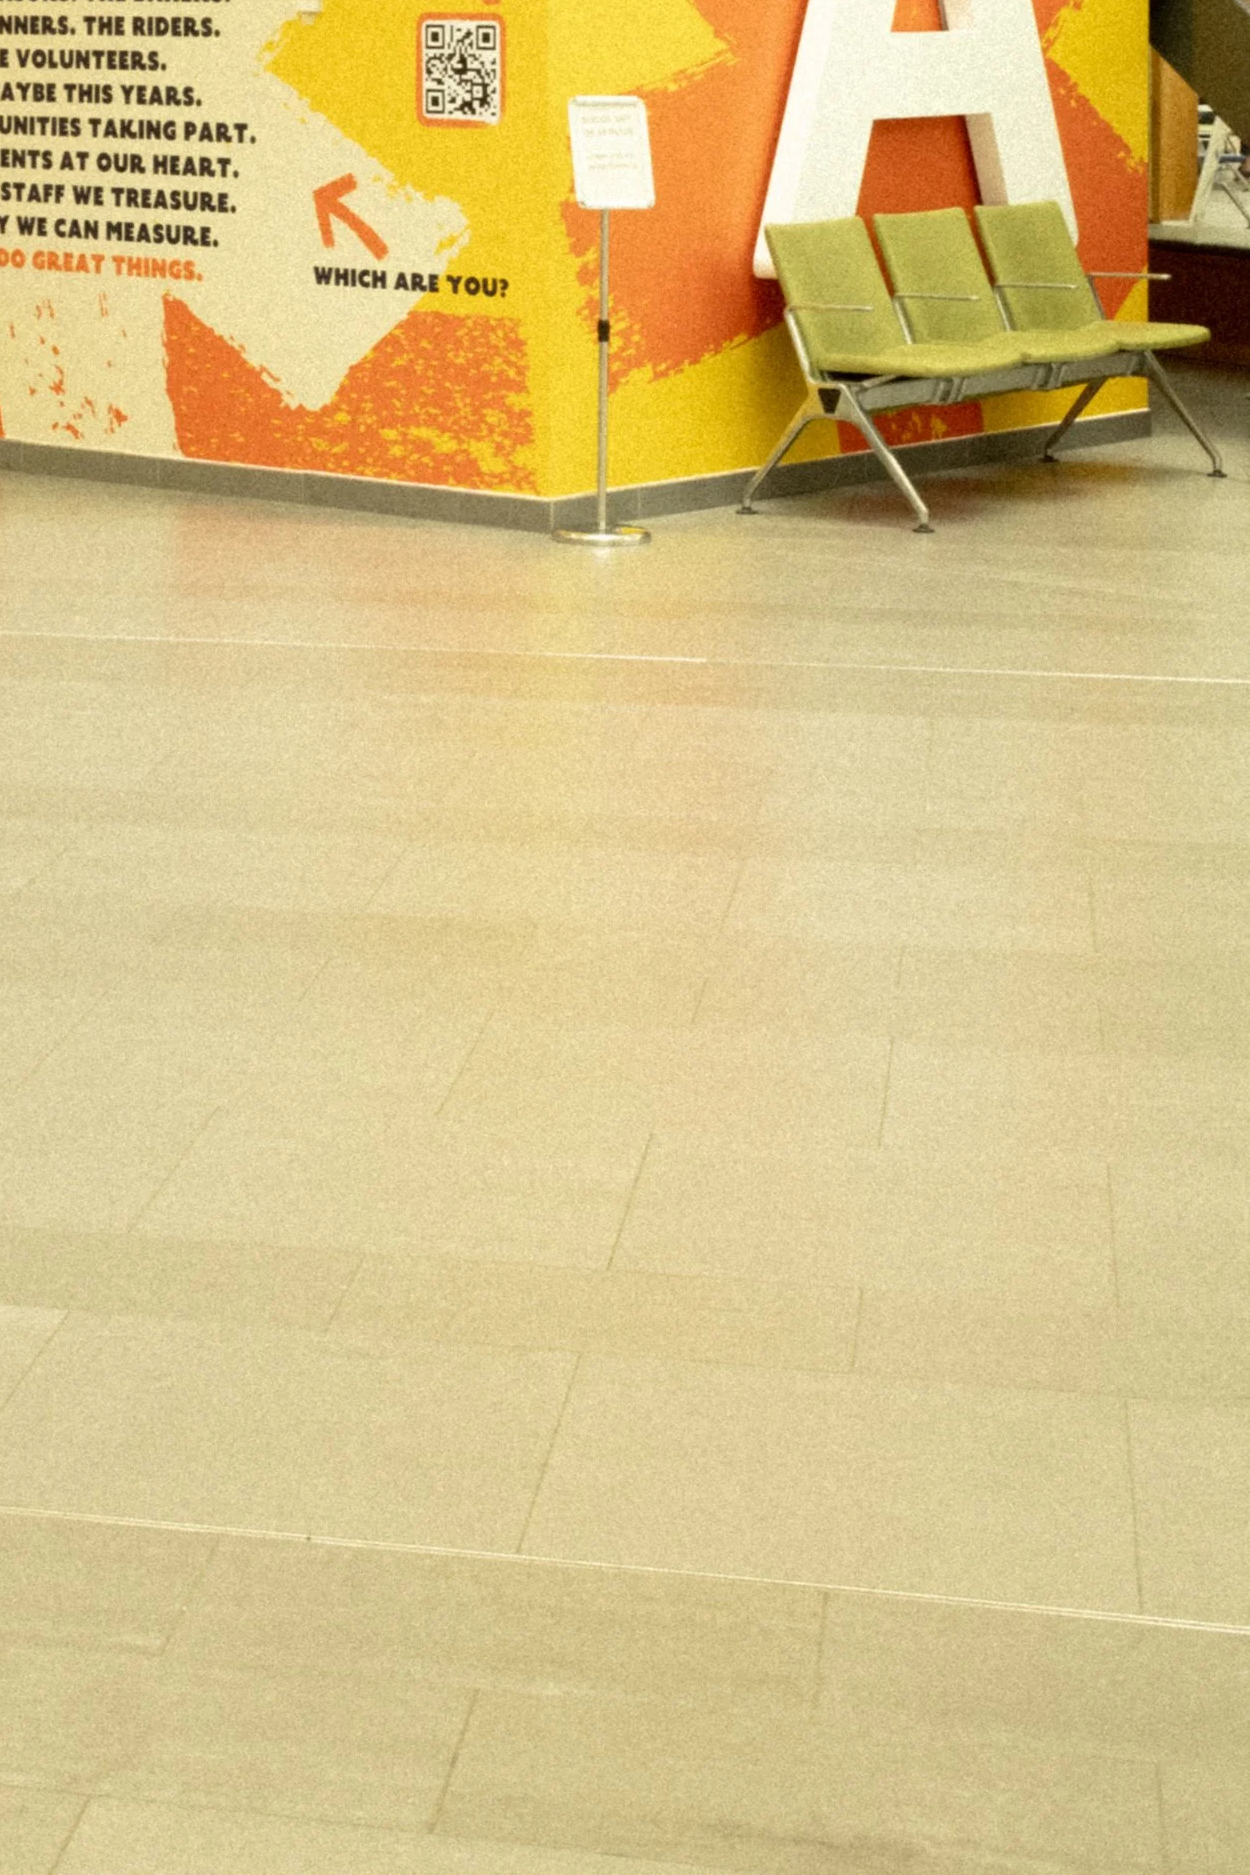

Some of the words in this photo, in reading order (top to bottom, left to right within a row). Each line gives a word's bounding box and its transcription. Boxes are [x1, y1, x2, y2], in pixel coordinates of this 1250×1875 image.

[83, 16, 125, 36] THE
[132, 16, 220, 38] RIDERS.
[16, 48, 166, 71] VOLUNTEERS.
[64, 82, 112, 104] THIS
[120, 85, 201, 107] YEARS.
[89, 117, 176, 141] TAKING
[183, 121, 256, 145] PART.
[60, 151, 89, 171] AT
[96, 152, 145, 174] OUR
[153, 154, 239, 179] HEART.
[1, 181, 65, 205] STAFF
[72, 185, 104, 207] WE
[111, 187, 236, 214] TREASURE.
[16, 216, 47, 237] WE
[54, 218, 99, 240] CAN
[106, 221, 219, 248] MEASURE.
[32, 250, 105, 275] GREAT
[112, 255, 203, 282] THINGS.
[313, 266, 387, 290] WHICH
[394, 271, 440, 293] ARE
[446, 275, 509, 298] YOU?
